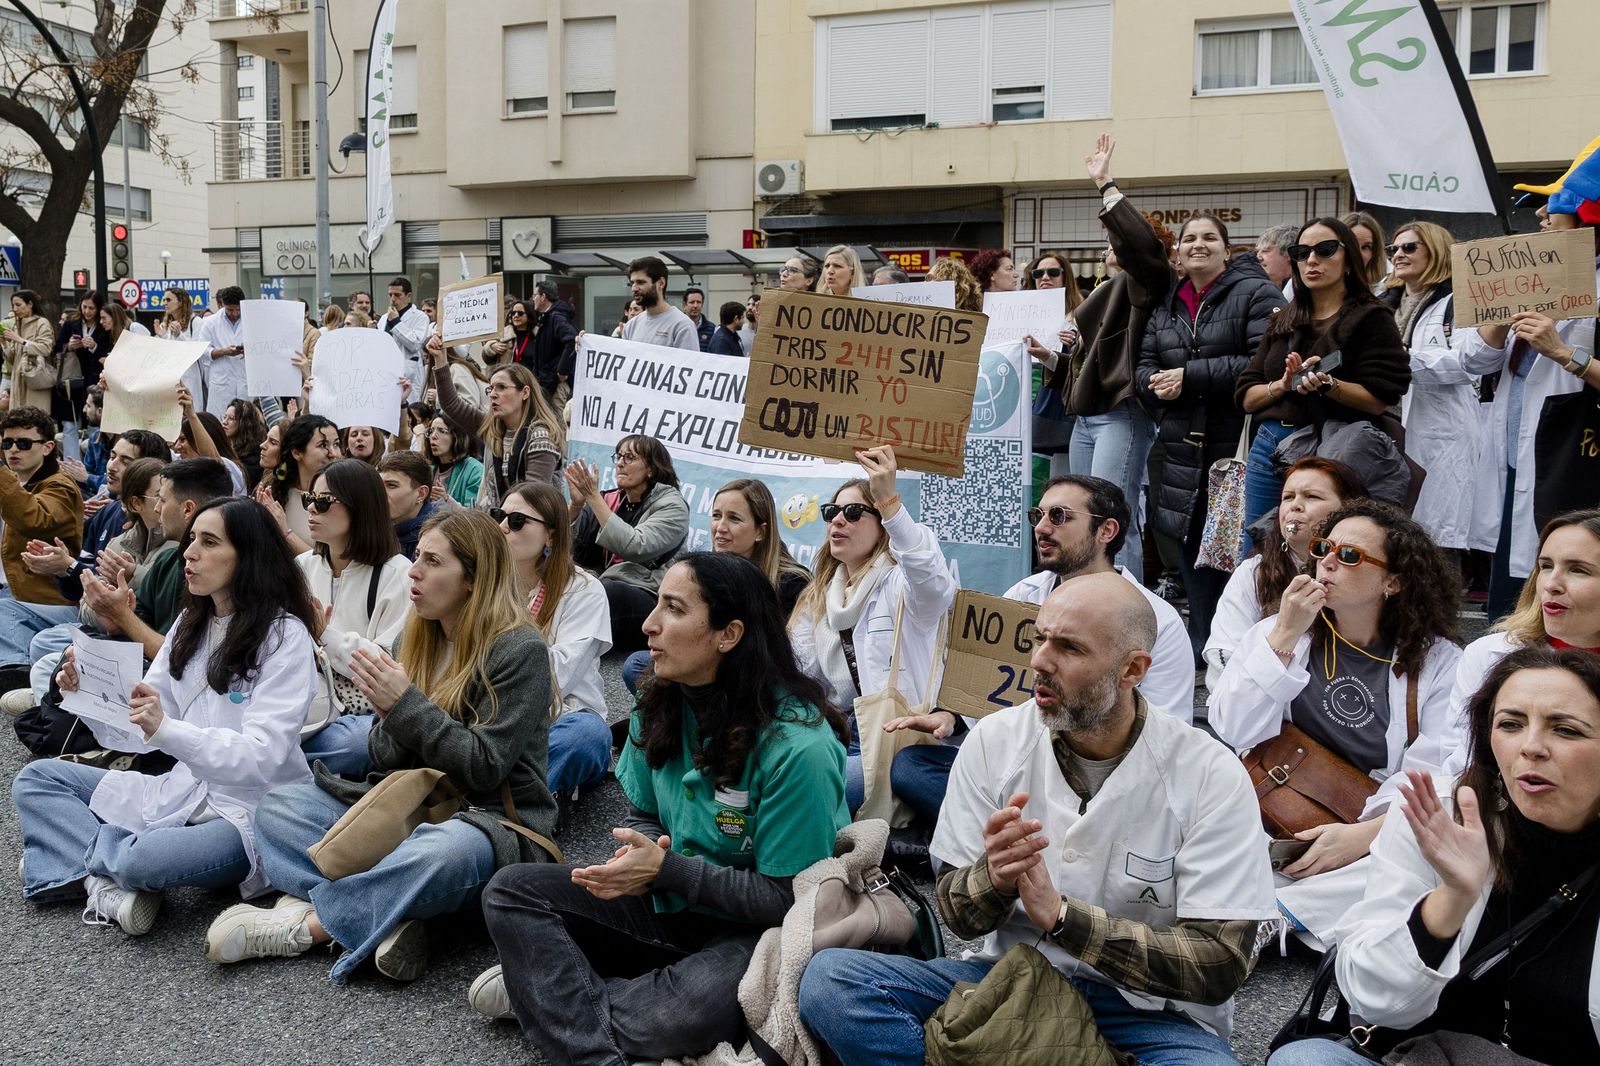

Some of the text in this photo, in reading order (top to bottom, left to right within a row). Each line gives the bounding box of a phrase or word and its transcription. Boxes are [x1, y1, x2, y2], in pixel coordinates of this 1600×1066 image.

[1539, 249, 1564, 265] en
[124, 288, 137, 298] 20
[459, 297, 489, 309] MÉDICA
[1467, 273, 1552, 308] HUELGA,
[454, 312, 487, 324] ESCLAVA
[775, 304, 974, 345] NO CONDUCIRÍAS
[1474, 305, 1511, 323] HARTA
[1535, 301, 1559, 313] ESTE
[585, 350, 747, 404] POR UNAS CON
[772, 334, 827, 361] TRAS
[899, 348, 945, 384] SIN
[769, 364, 907, 405] DORMIR YO
[581, 395, 603, 428] NO
[603, 400, 617, 430] A
[620, 404, 650, 435] LA
[758, 397, 971, 457] COJO UN BISTURÍ
[962, 604, 1004, 645] NO
[987, 665, 1036, 708] 24
[1326, 711, 1346, 726] DENTRO
[716, 817, 744, 825] HUELGA
